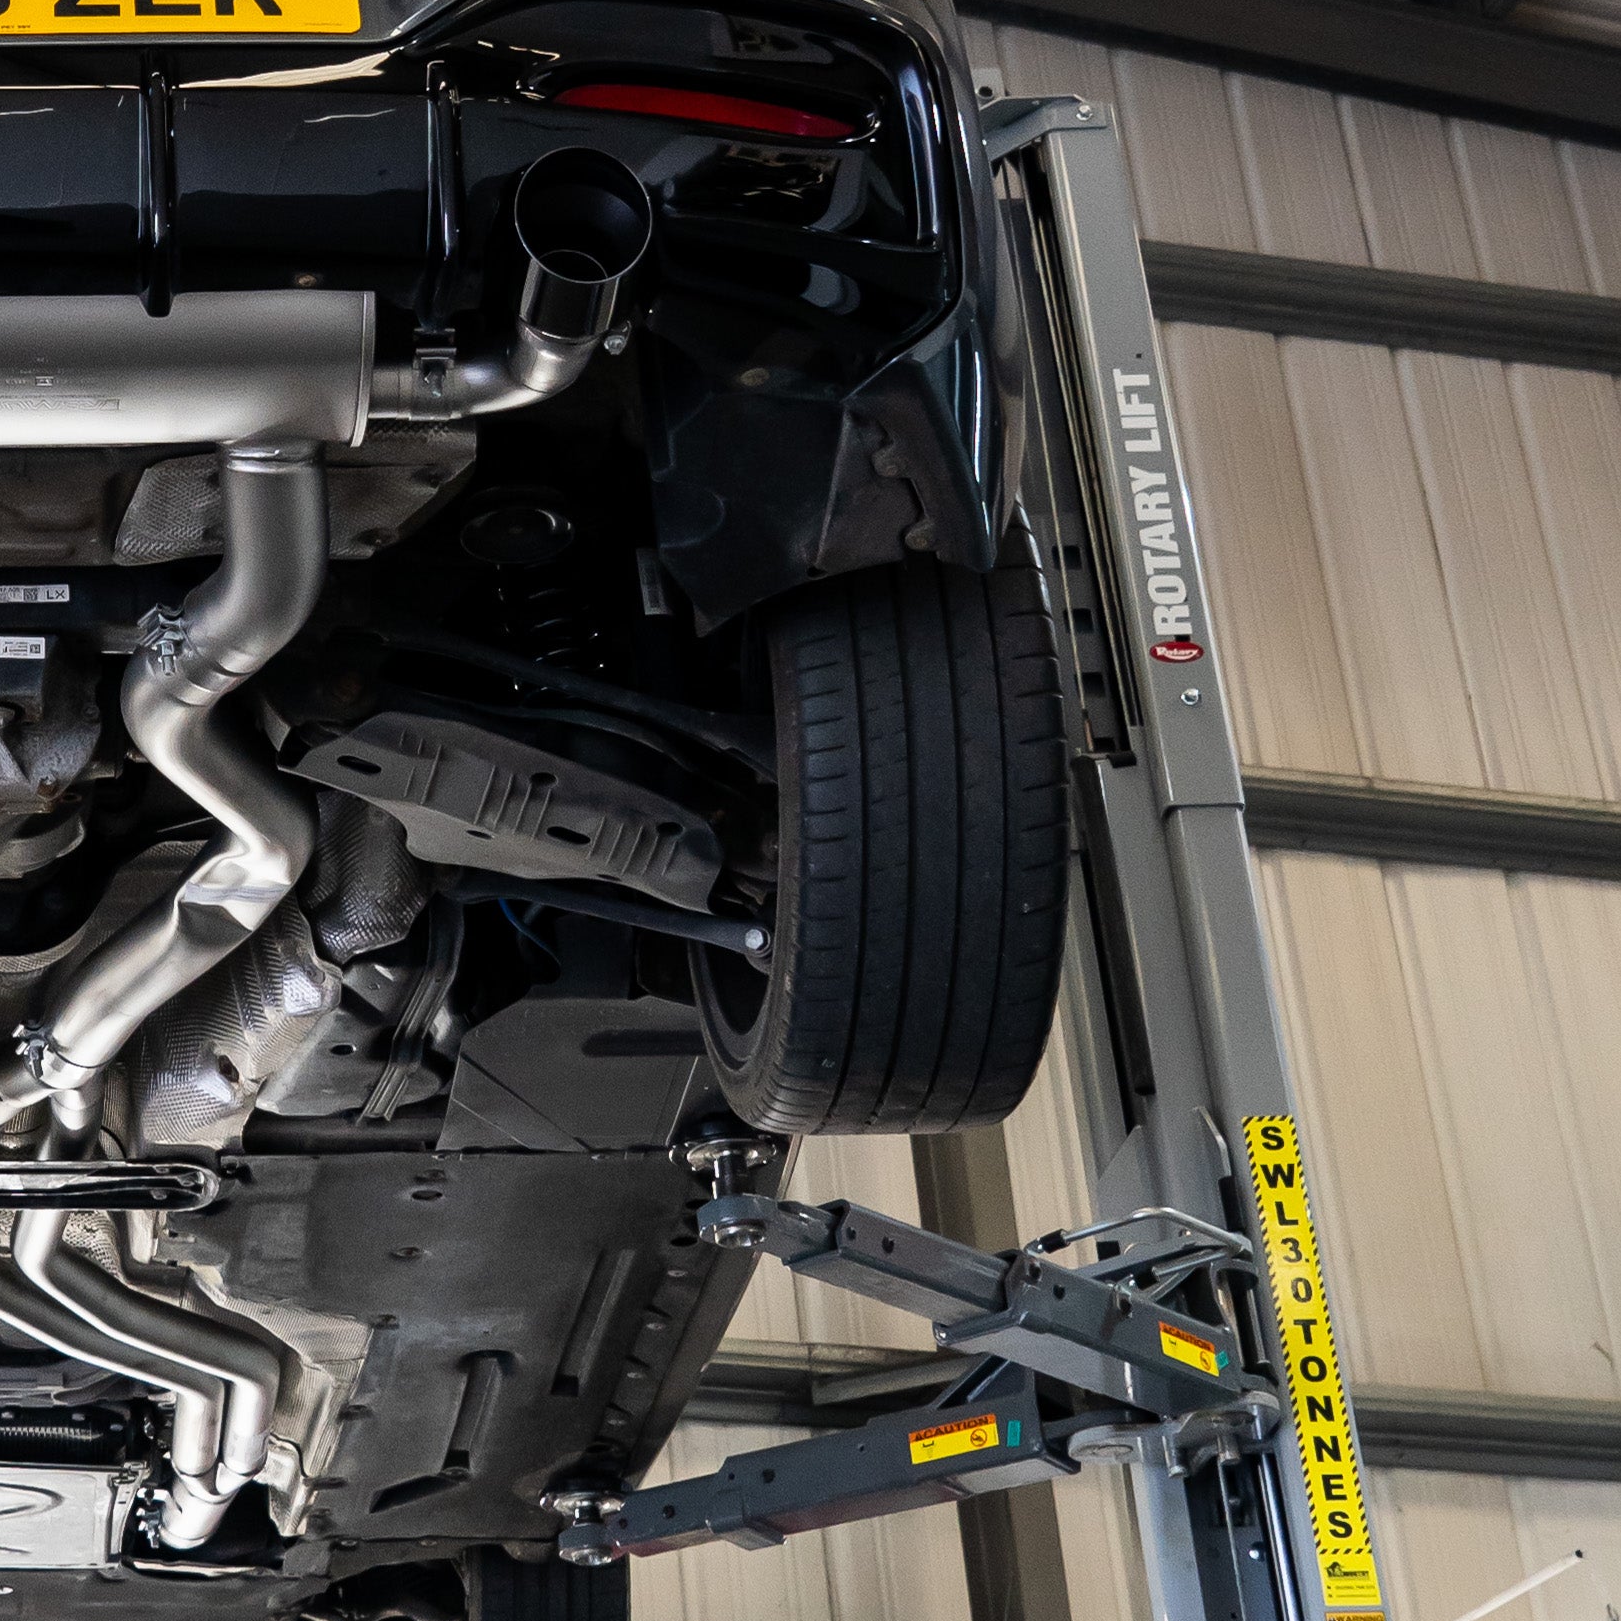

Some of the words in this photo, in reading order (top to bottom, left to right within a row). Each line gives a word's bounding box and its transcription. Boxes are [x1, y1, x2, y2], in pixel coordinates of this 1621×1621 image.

[1112, 368, 1163, 453] LIFT
[1129, 465, 1193, 636] ROTARY
[46, 589, 65, 600] LX
[923, 1416, 989, 1439] CAUTION
[1293, 1316, 1354, 1540] TONNES
